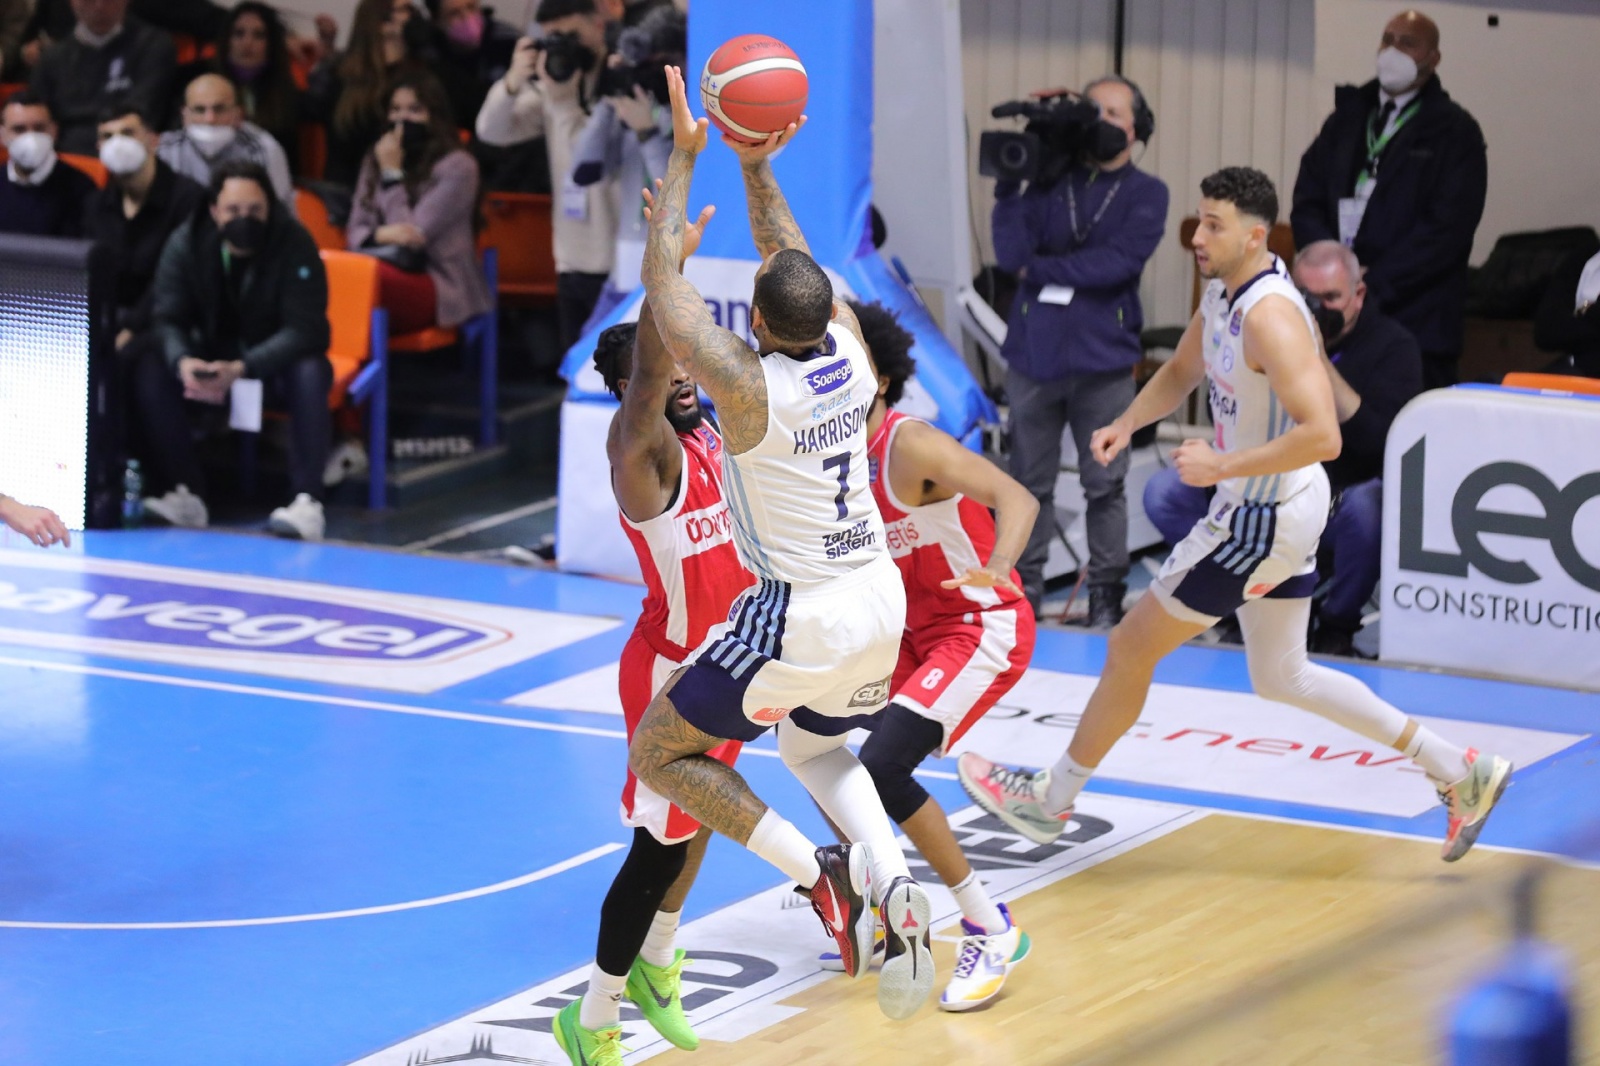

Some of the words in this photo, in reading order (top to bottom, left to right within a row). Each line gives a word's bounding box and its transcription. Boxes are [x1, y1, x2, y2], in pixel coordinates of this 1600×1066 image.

[793, 402, 868, 455] HARRISON
[823, 451, 852, 522] 7
[826, 531, 876, 560] sistem
[1393, 583, 1600, 632] CONSTRUCTI
[920, 667, 945, 690] 8
